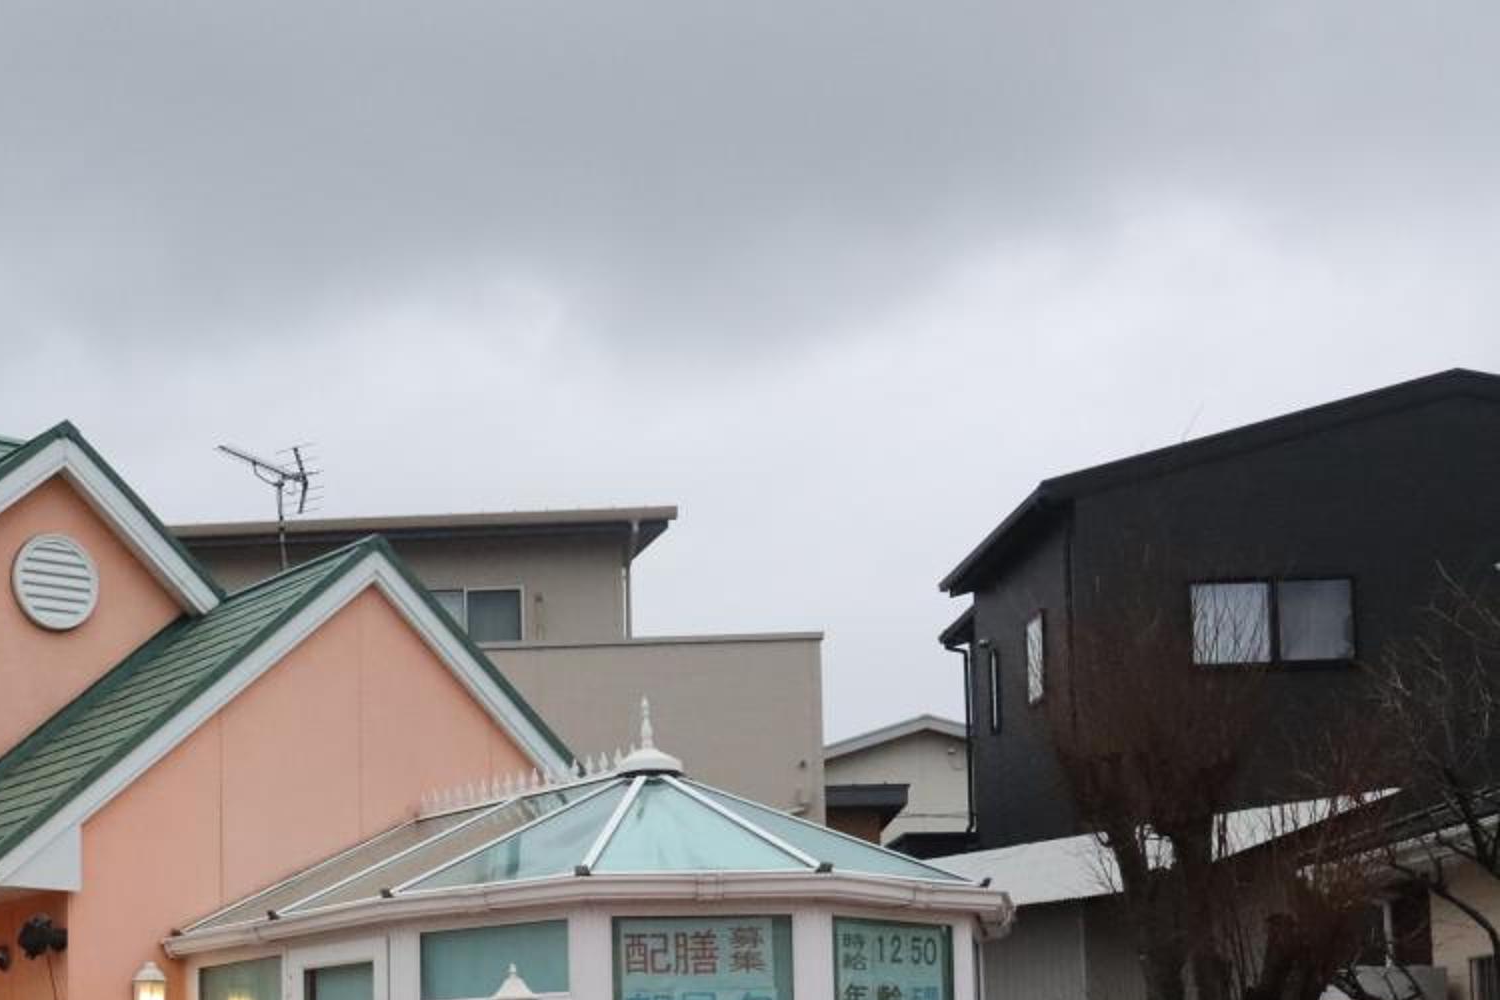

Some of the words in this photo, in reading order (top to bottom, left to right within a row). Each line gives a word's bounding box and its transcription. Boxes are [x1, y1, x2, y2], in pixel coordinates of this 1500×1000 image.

[624, 930, 719, 975] 配膳
[728, 926, 766, 973] 募集
[877, 934, 938, 966] 1250
